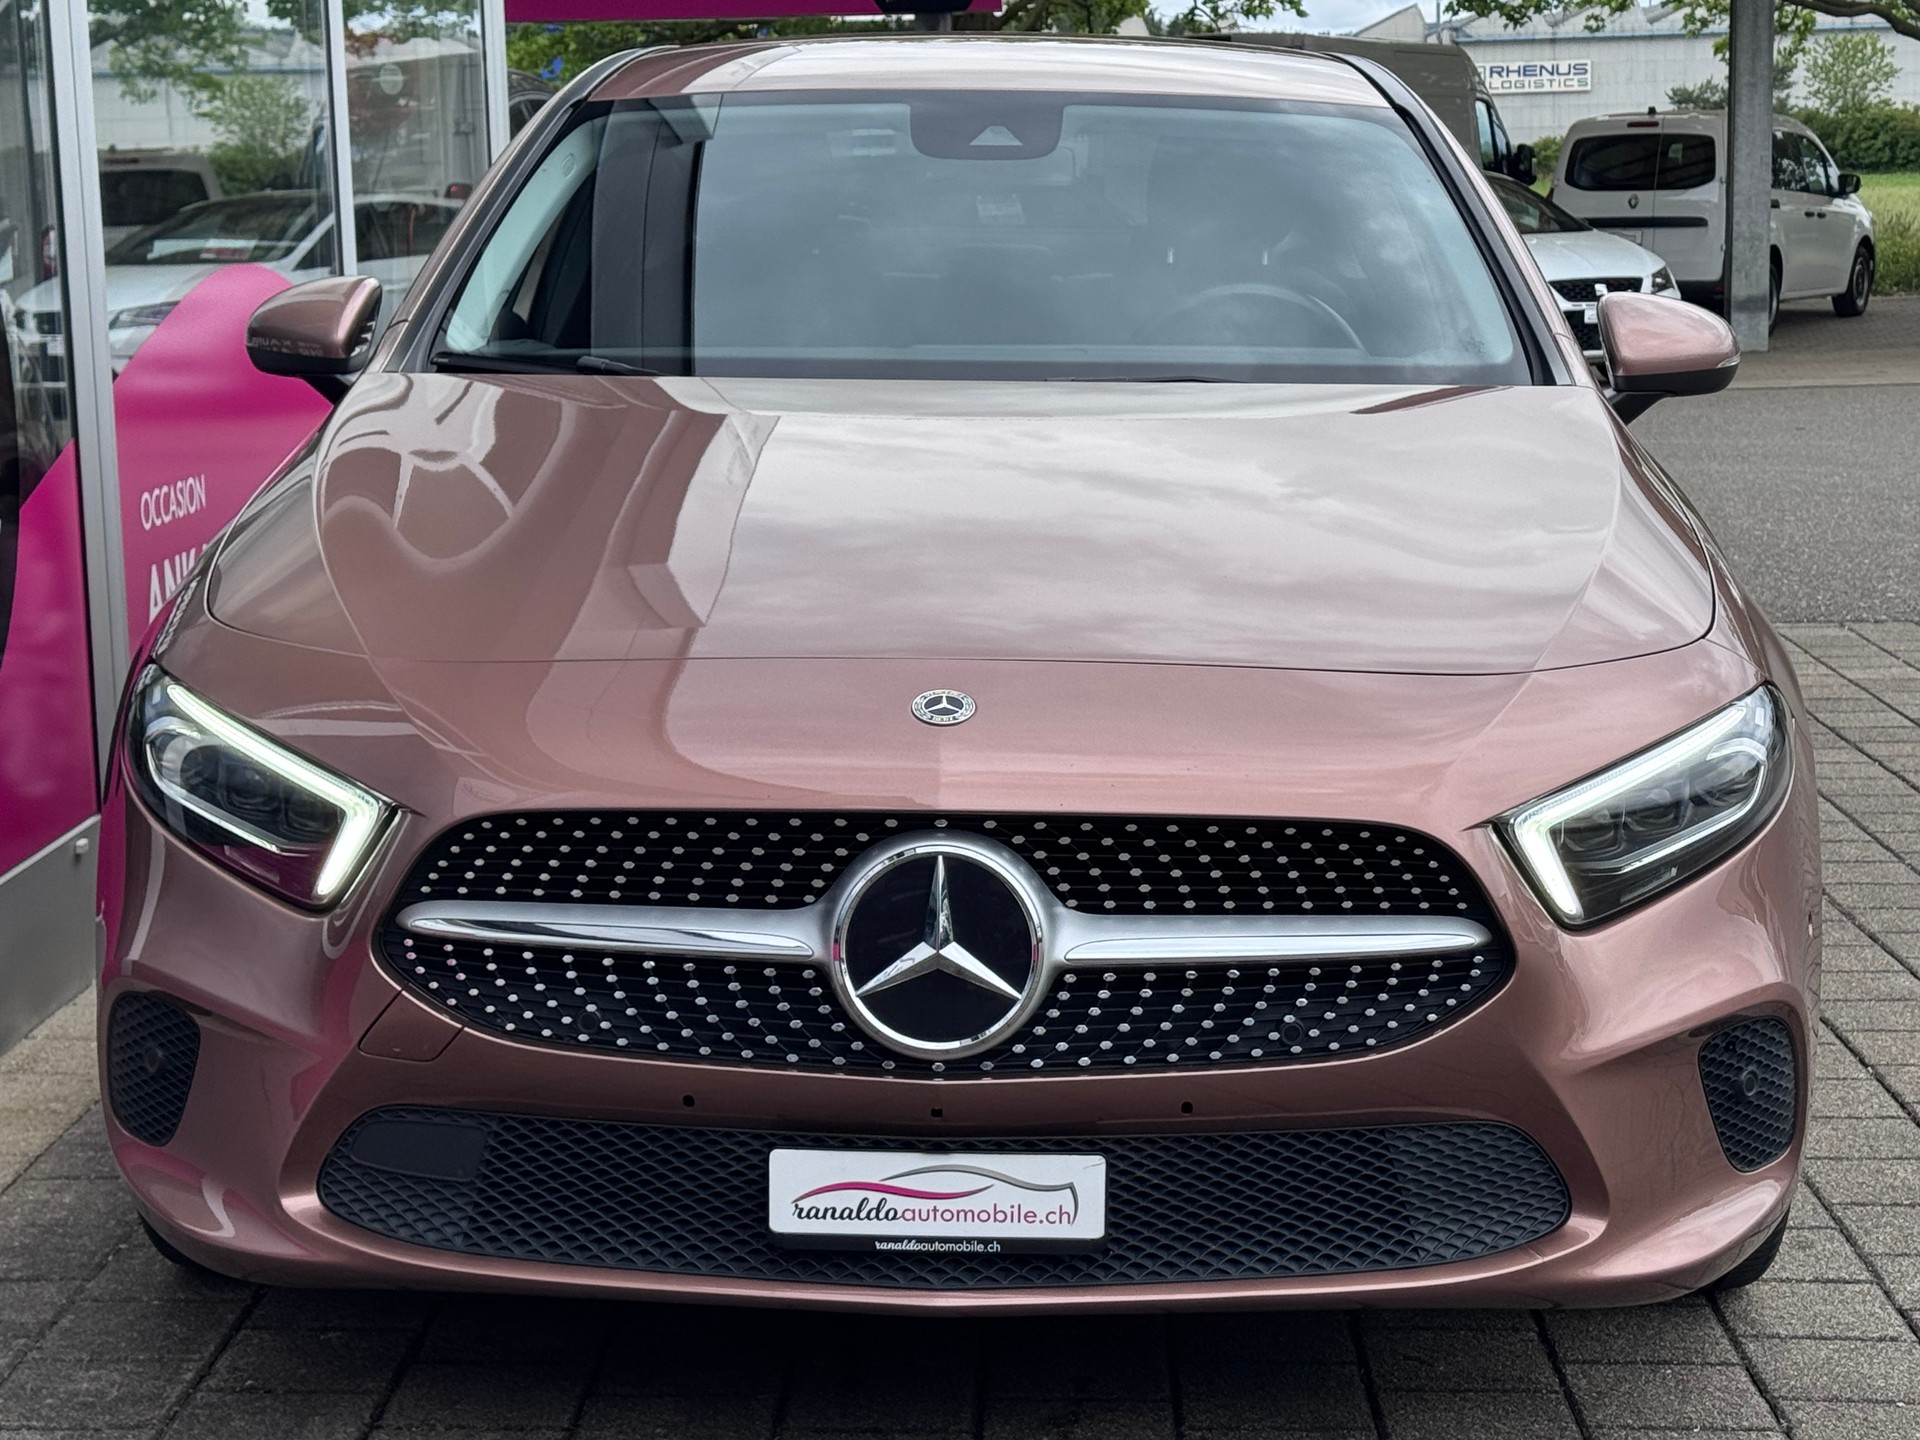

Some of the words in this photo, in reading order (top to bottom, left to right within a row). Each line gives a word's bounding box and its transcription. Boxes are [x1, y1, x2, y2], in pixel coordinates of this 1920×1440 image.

[1489, 63, 1588, 78] RHENUS
[1489, 78, 1588, 90] LOGISTICS
[140, 474, 207, 531] OCCASION
[792, 1197, 1071, 1225] ranaldoautomobile.ch
[875, 1239, 1001, 1252] ranaldoautomobile.ch
